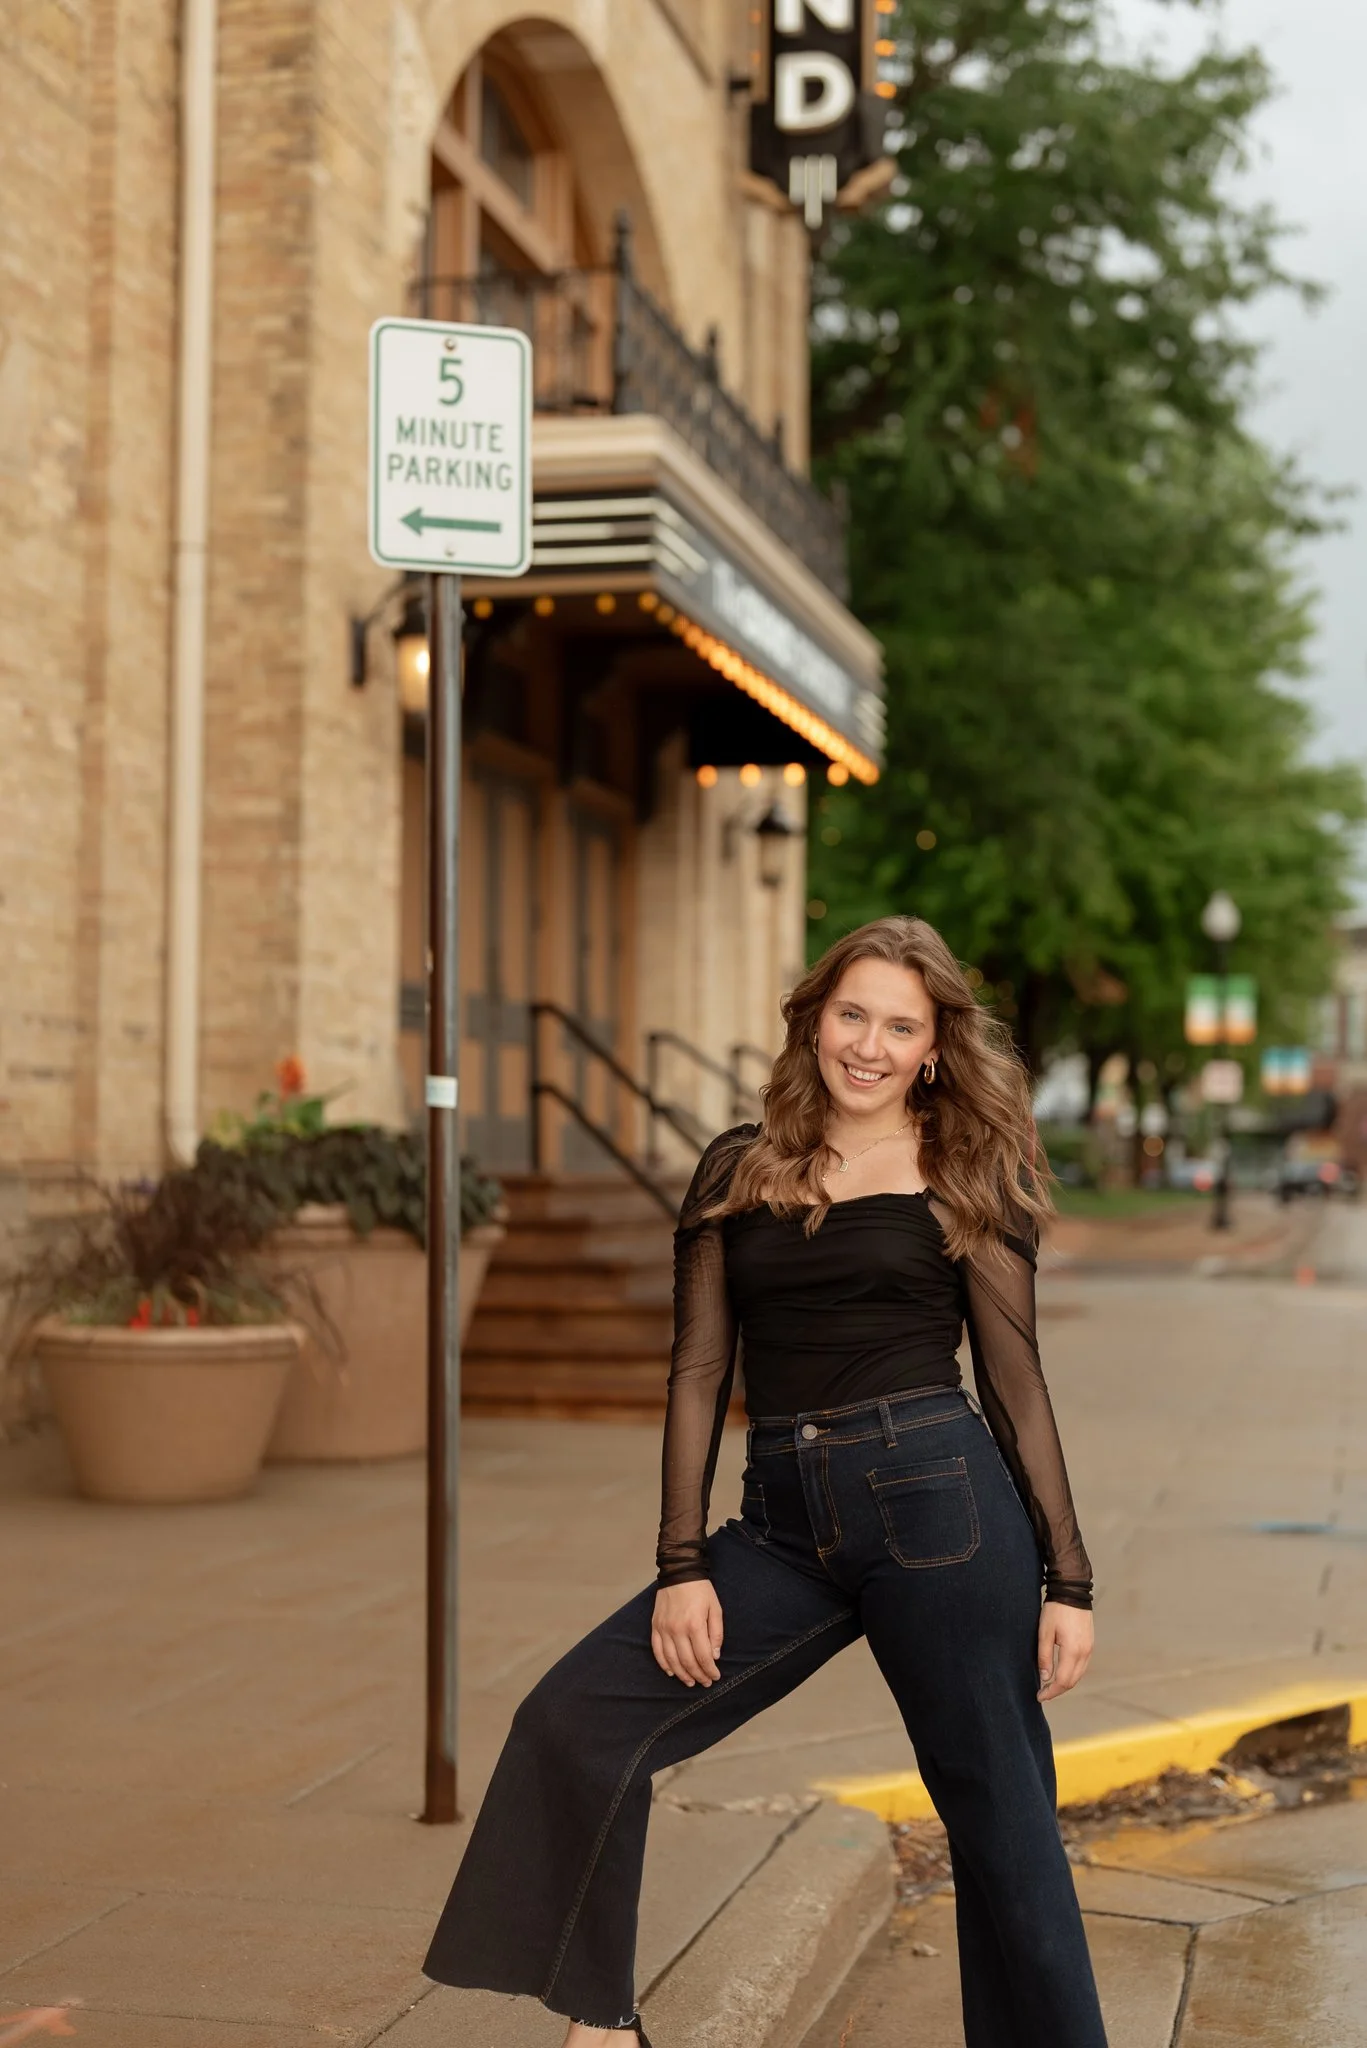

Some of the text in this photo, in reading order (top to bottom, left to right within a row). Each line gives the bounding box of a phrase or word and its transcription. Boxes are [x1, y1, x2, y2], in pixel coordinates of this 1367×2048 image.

[438, 357, 464, 406] 5
[396, 416, 504, 453] MINUTE
[387, 453, 513, 491] PARKING
